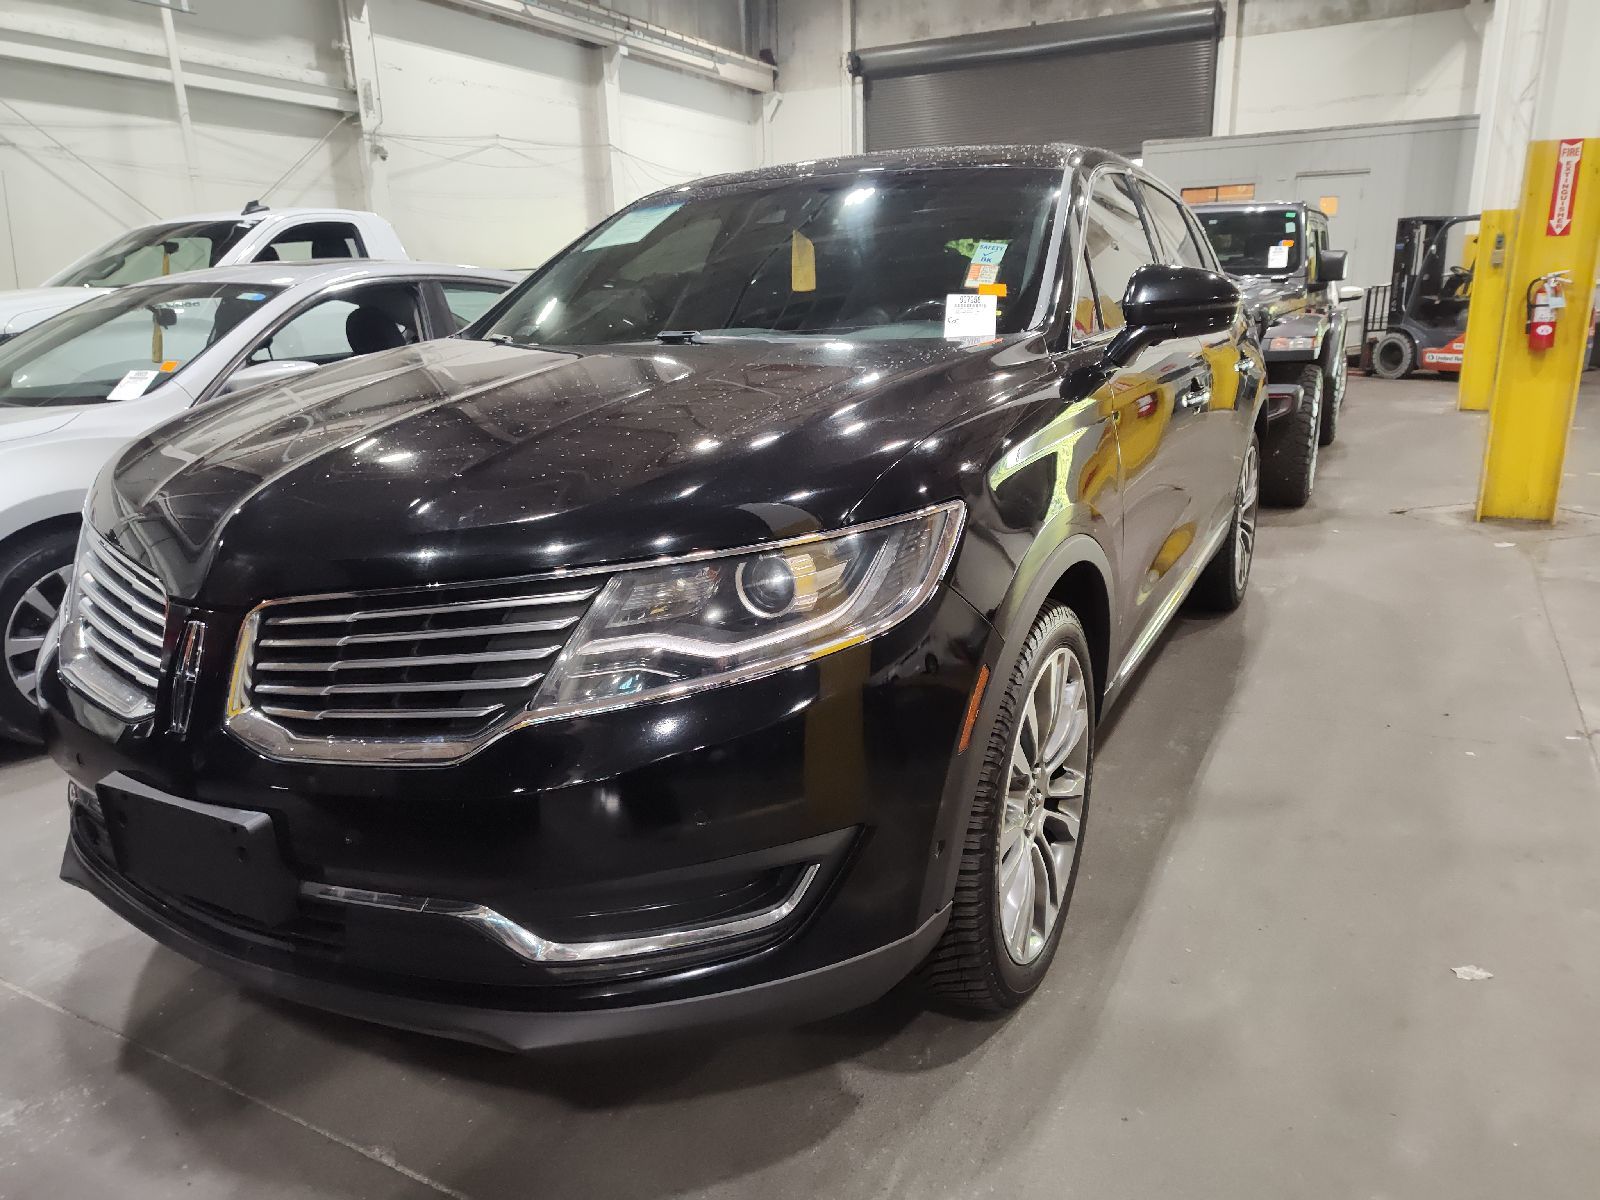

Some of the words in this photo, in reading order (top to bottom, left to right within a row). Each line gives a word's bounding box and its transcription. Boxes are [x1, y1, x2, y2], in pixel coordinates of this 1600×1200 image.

[1562, 147, 1580, 157] FIRE
[1556, 161, 1572, 229] EXTINGUISHER
[980, 244, 1004, 252] SAFETY
